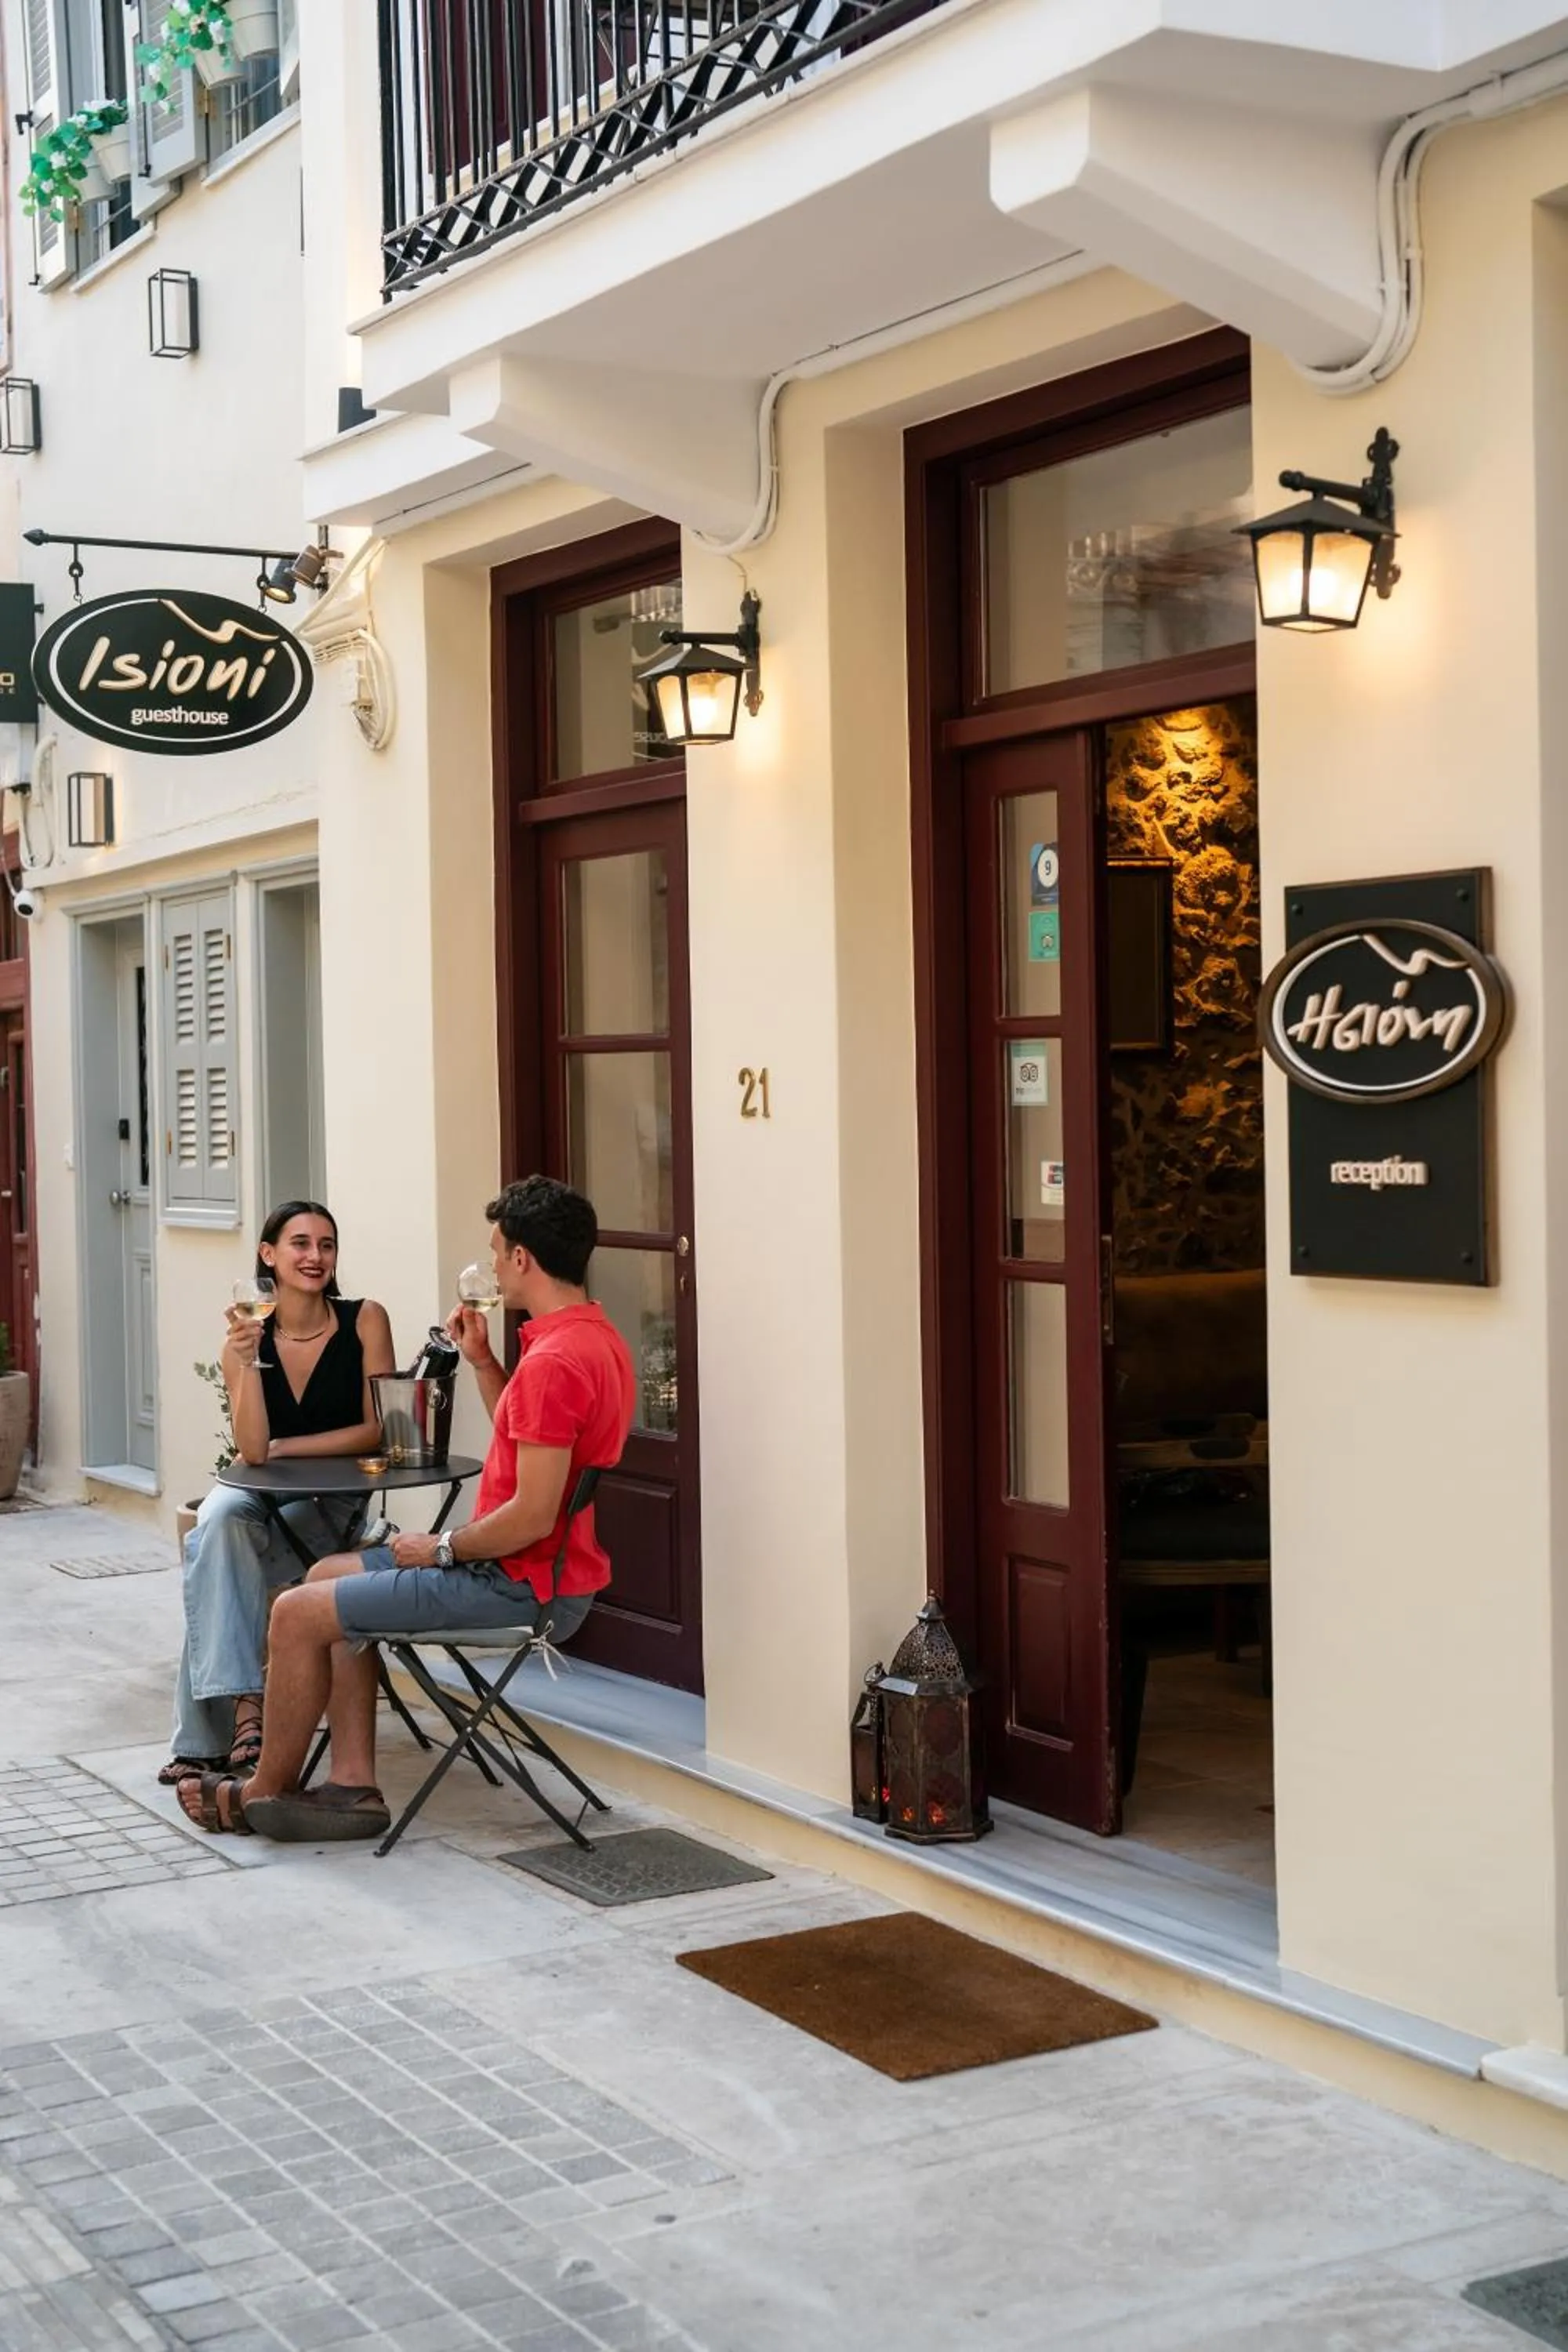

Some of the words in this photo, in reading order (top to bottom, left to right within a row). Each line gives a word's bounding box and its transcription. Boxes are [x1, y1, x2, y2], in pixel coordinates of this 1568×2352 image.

[80, 636, 276, 701] Isioni
[131, 705, 230, 725] guesthouse
[739, 1067, 770, 1119] 21
[1330, 1154, 1426, 1191] reception
